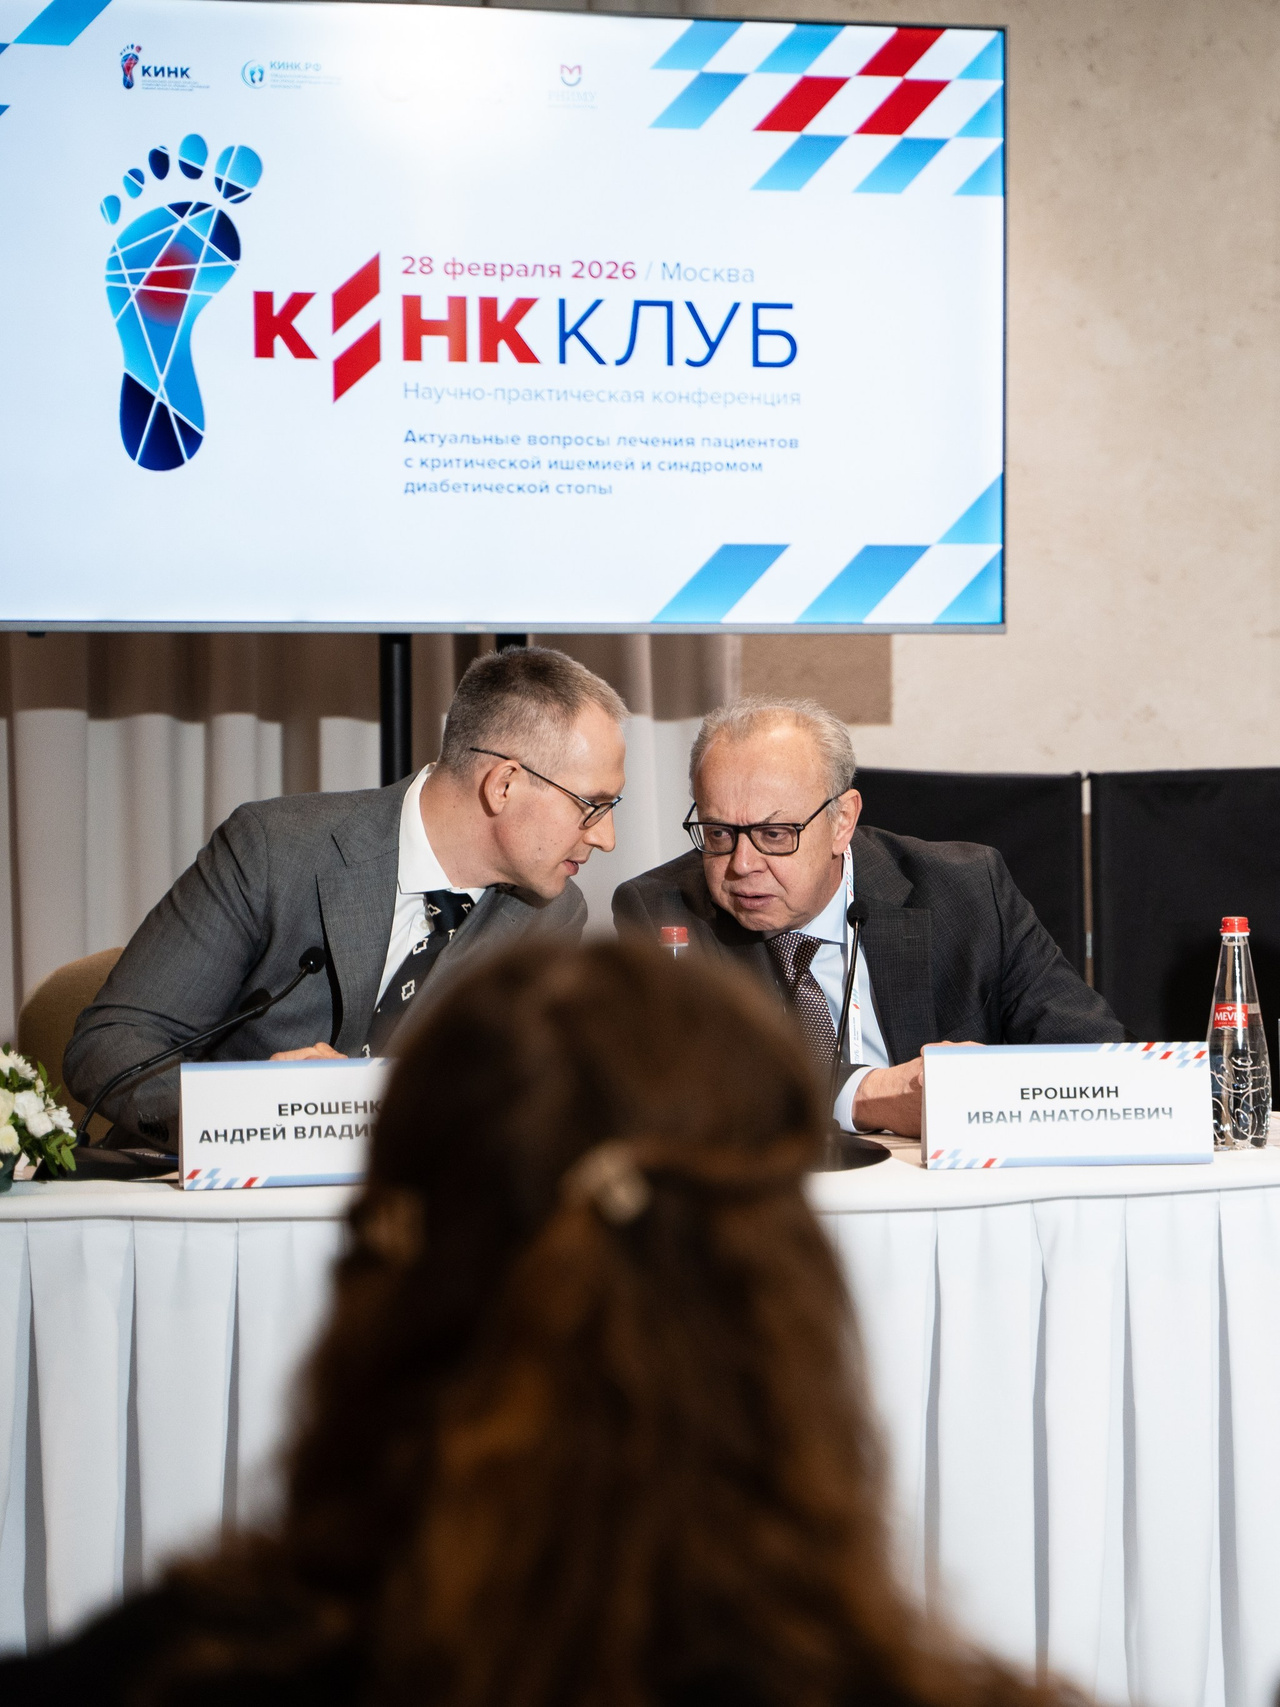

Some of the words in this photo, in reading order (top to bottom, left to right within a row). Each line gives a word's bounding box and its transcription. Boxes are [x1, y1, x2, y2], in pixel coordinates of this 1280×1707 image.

[142, 65, 189, 78] КИНК
[402, 256, 433, 275] 28
[444, 257, 561, 282] февраля
[571, 260, 636, 279] 2026
[661, 262, 754, 283] Москва
[558, 298, 797, 368] КЛУБ
[403, 381, 644, 405] Научно-практическая
[651, 387, 800, 408] конференция
[404, 429, 521, 447] Актуальные
[527, 435, 610, 449] вопросы
[617, 436, 695, 447] лечения
[701, 437, 799, 450] пациентов
[404, 457, 413, 468] с
[420, 456, 541, 471] критической
[548, 460, 635, 470] ишемией
[641, 461, 651, 470] и
[658, 461, 764, 475] синдромом
[404, 479, 549, 494] диабетической
[555, 484, 612, 495] стопы
[1021, 1086, 1118, 1100] ЕРОШКИН
[278, 1100, 382, 1117] ЕРОШЕНК
[968, 1111, 1021, 1124] ИВАН
[1030, 1107, 1172, 1122] АНАТОЛЬЕВИЧ
[198, 1124, 287, 1145] АНДРЕЙ
[294, 1123, 374, 1141] ВЛАДИ
